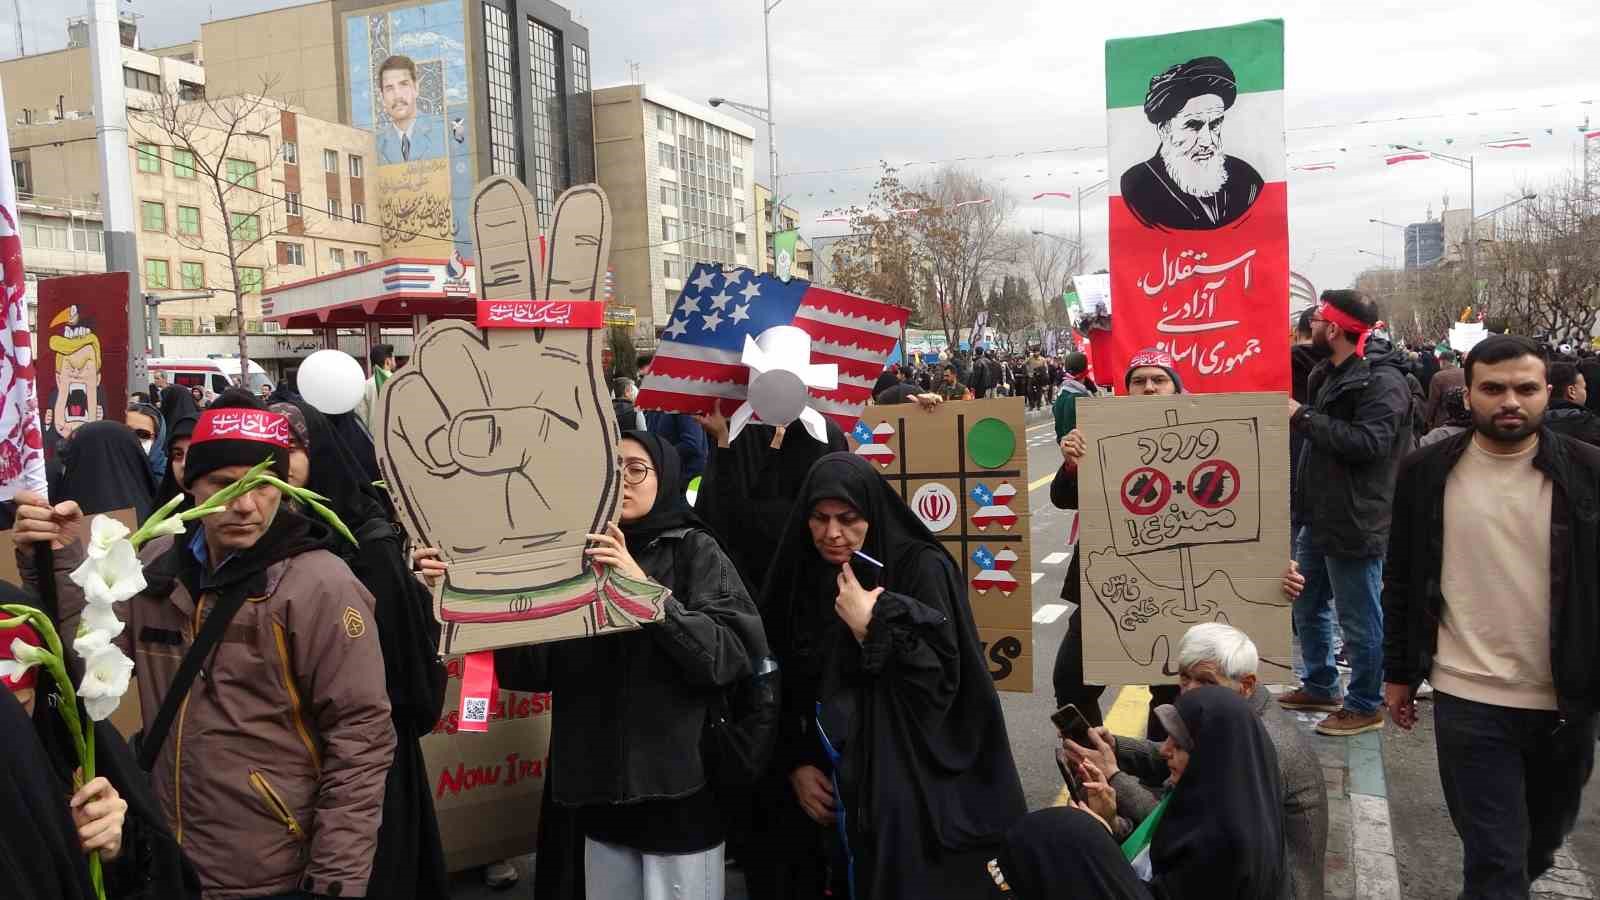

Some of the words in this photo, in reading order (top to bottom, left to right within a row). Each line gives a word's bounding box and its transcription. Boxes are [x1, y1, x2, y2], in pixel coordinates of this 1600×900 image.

[1199, 338, 1262, 375] جمهوری
[1137, 428, 1219, 465] ورود
[1127, 503, 1237, 547] ممنوع!
